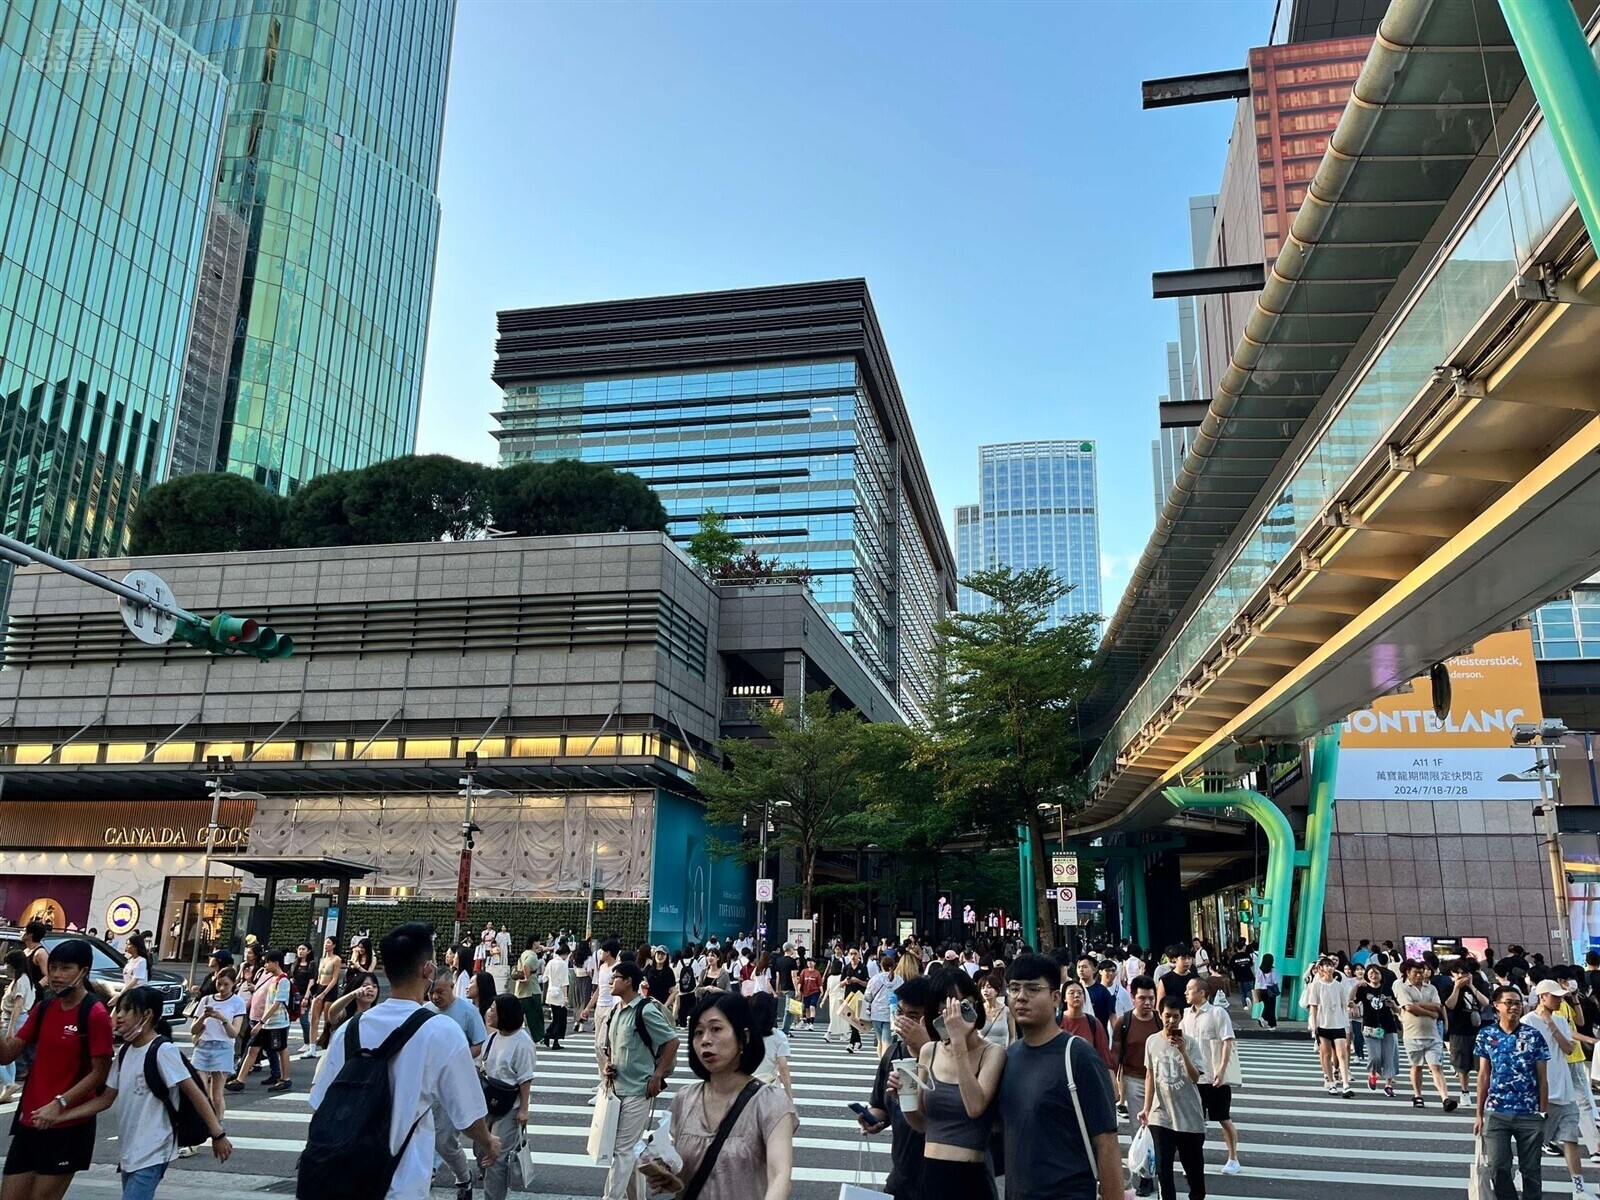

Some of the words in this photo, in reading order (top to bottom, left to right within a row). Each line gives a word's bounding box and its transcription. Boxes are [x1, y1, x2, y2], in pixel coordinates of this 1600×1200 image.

[1449, 655, 1522, 667] Meisterstück,
[732, 684, 772, 696] ENOTECA
[1412, 758, 1428, 767] A11
[1433, 758, 1443, 767] 1F
[1376, 771, 1483, 782] 萬寶龍期間限定快閃店
[1394, 786, 1468, 795] 2024/7/18-7/28
[103, 826, 188, 845] CANADA
[196, 826, 261, 845] GOOS
